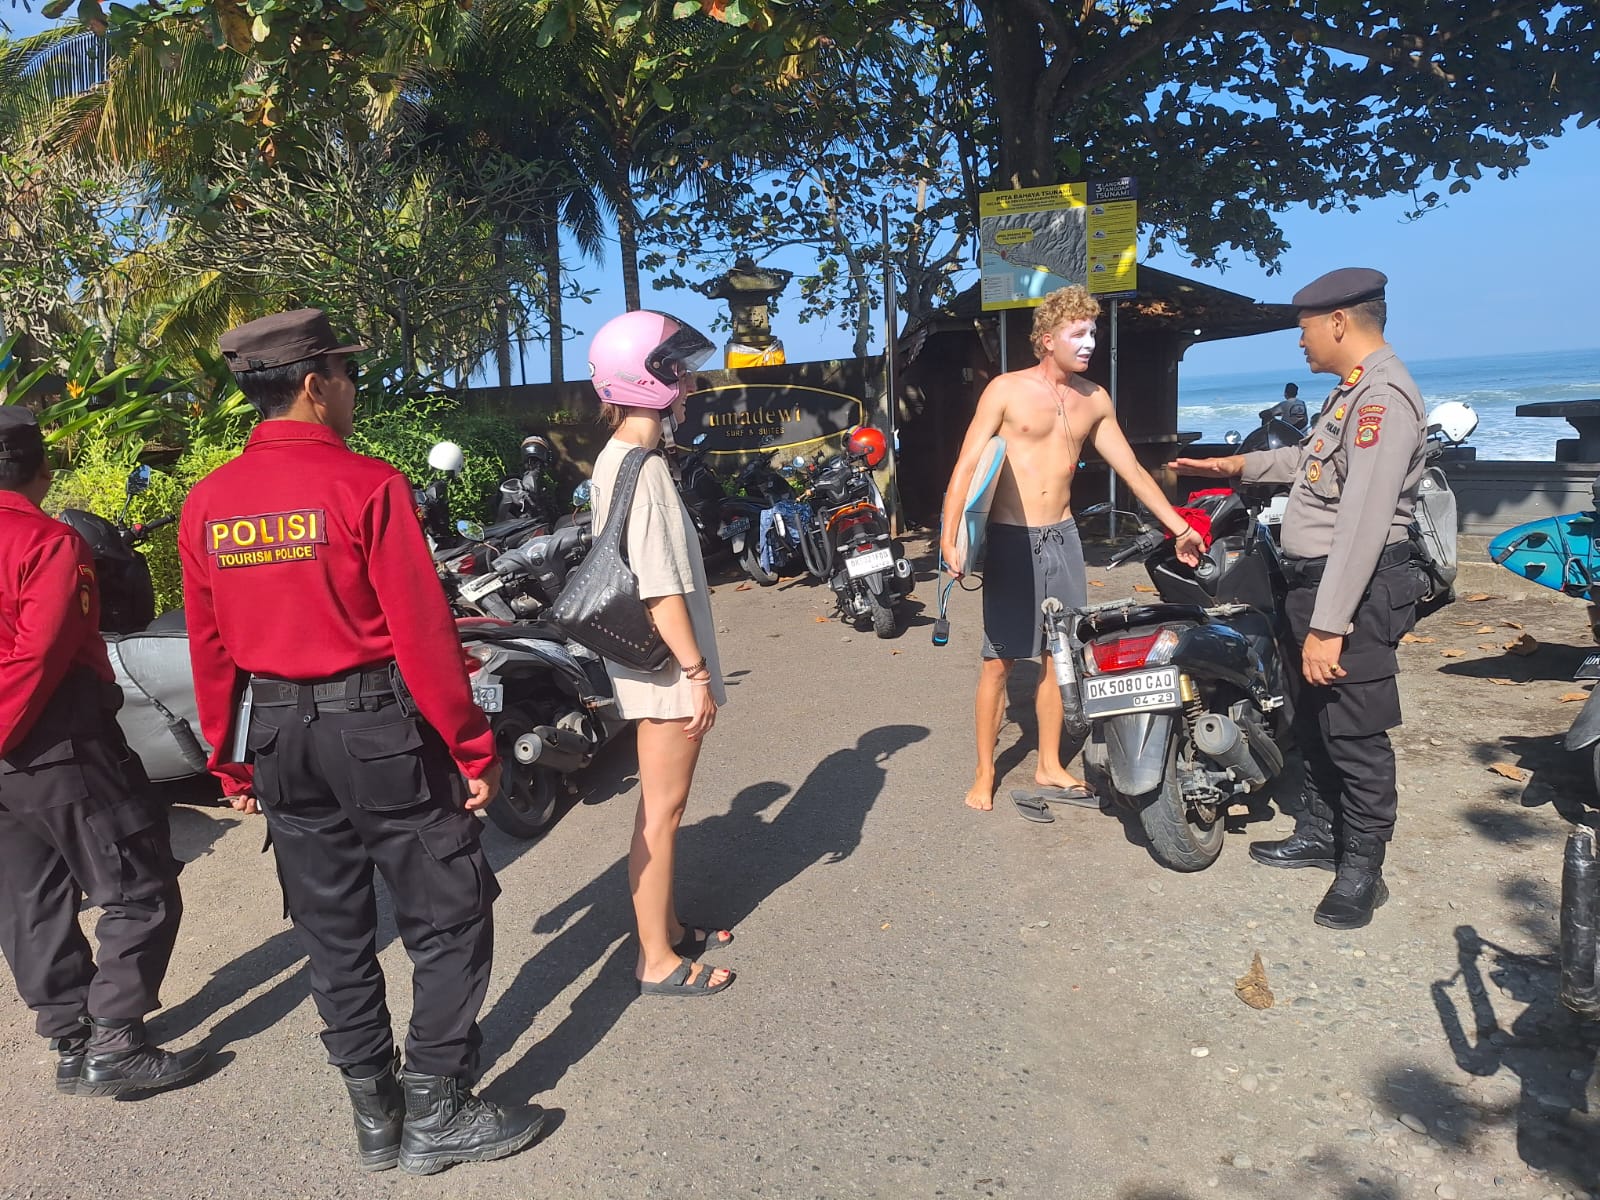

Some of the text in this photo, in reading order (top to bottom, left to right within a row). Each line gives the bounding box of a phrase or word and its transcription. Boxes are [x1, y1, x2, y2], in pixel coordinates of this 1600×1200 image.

[1095, 183, 1102, 193] 3
[1096, 190, 1130, 199] TSUNAMI
[996, 193, 1013, 201] PETA
[1013, 191, 1041, 200] BAHAYA
[709, 402, 801, 427] umadewi
[726, 429, 744, 437] SURF
[759, 427, 785, 436] SUITES
[212, 513, 317, 549] POLISI
[218, 545, 313, 566] TOURISM POLICE
[1090, 681, 1107, 698] DK
[1109, 677, 1142, 694] 5080
